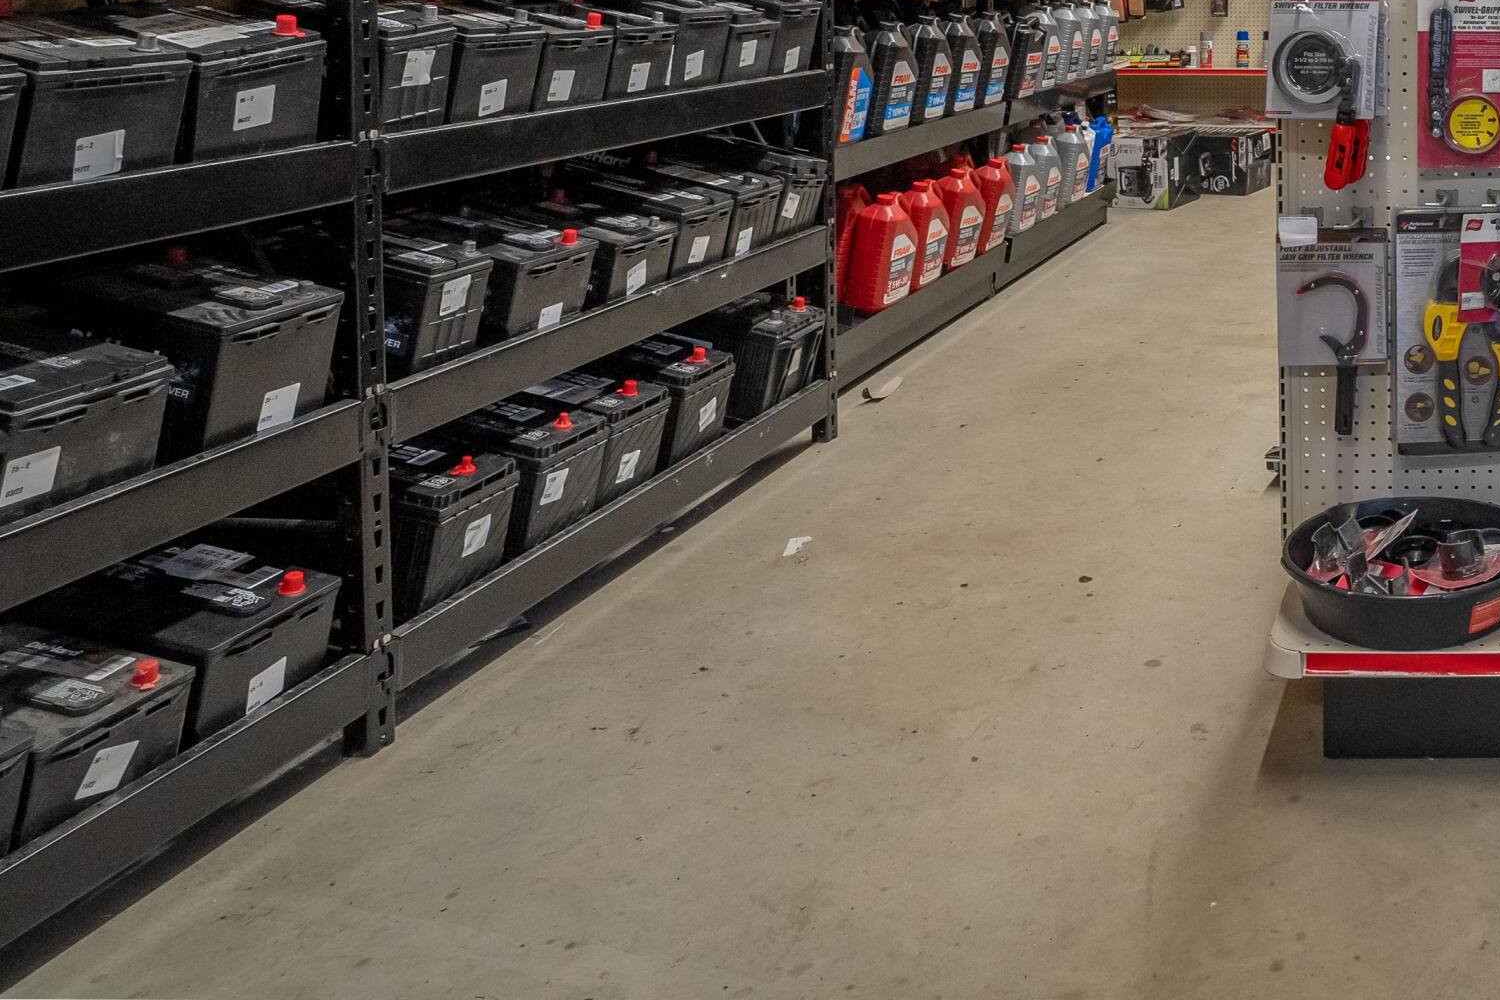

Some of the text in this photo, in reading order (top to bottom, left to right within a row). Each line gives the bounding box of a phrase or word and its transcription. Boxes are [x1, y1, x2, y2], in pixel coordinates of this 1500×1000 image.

[1339, 2, 1370, 10] WRENCH
[842, 80, 858, 135] FRAM
[962, 216, 979, 227] FRAM
[929, 229, 943, 241] FRAM
[893, 245, 911, 258] FRAM
[1279, 253, 1374, 261] JAW GRIP FILTER WRENCH
